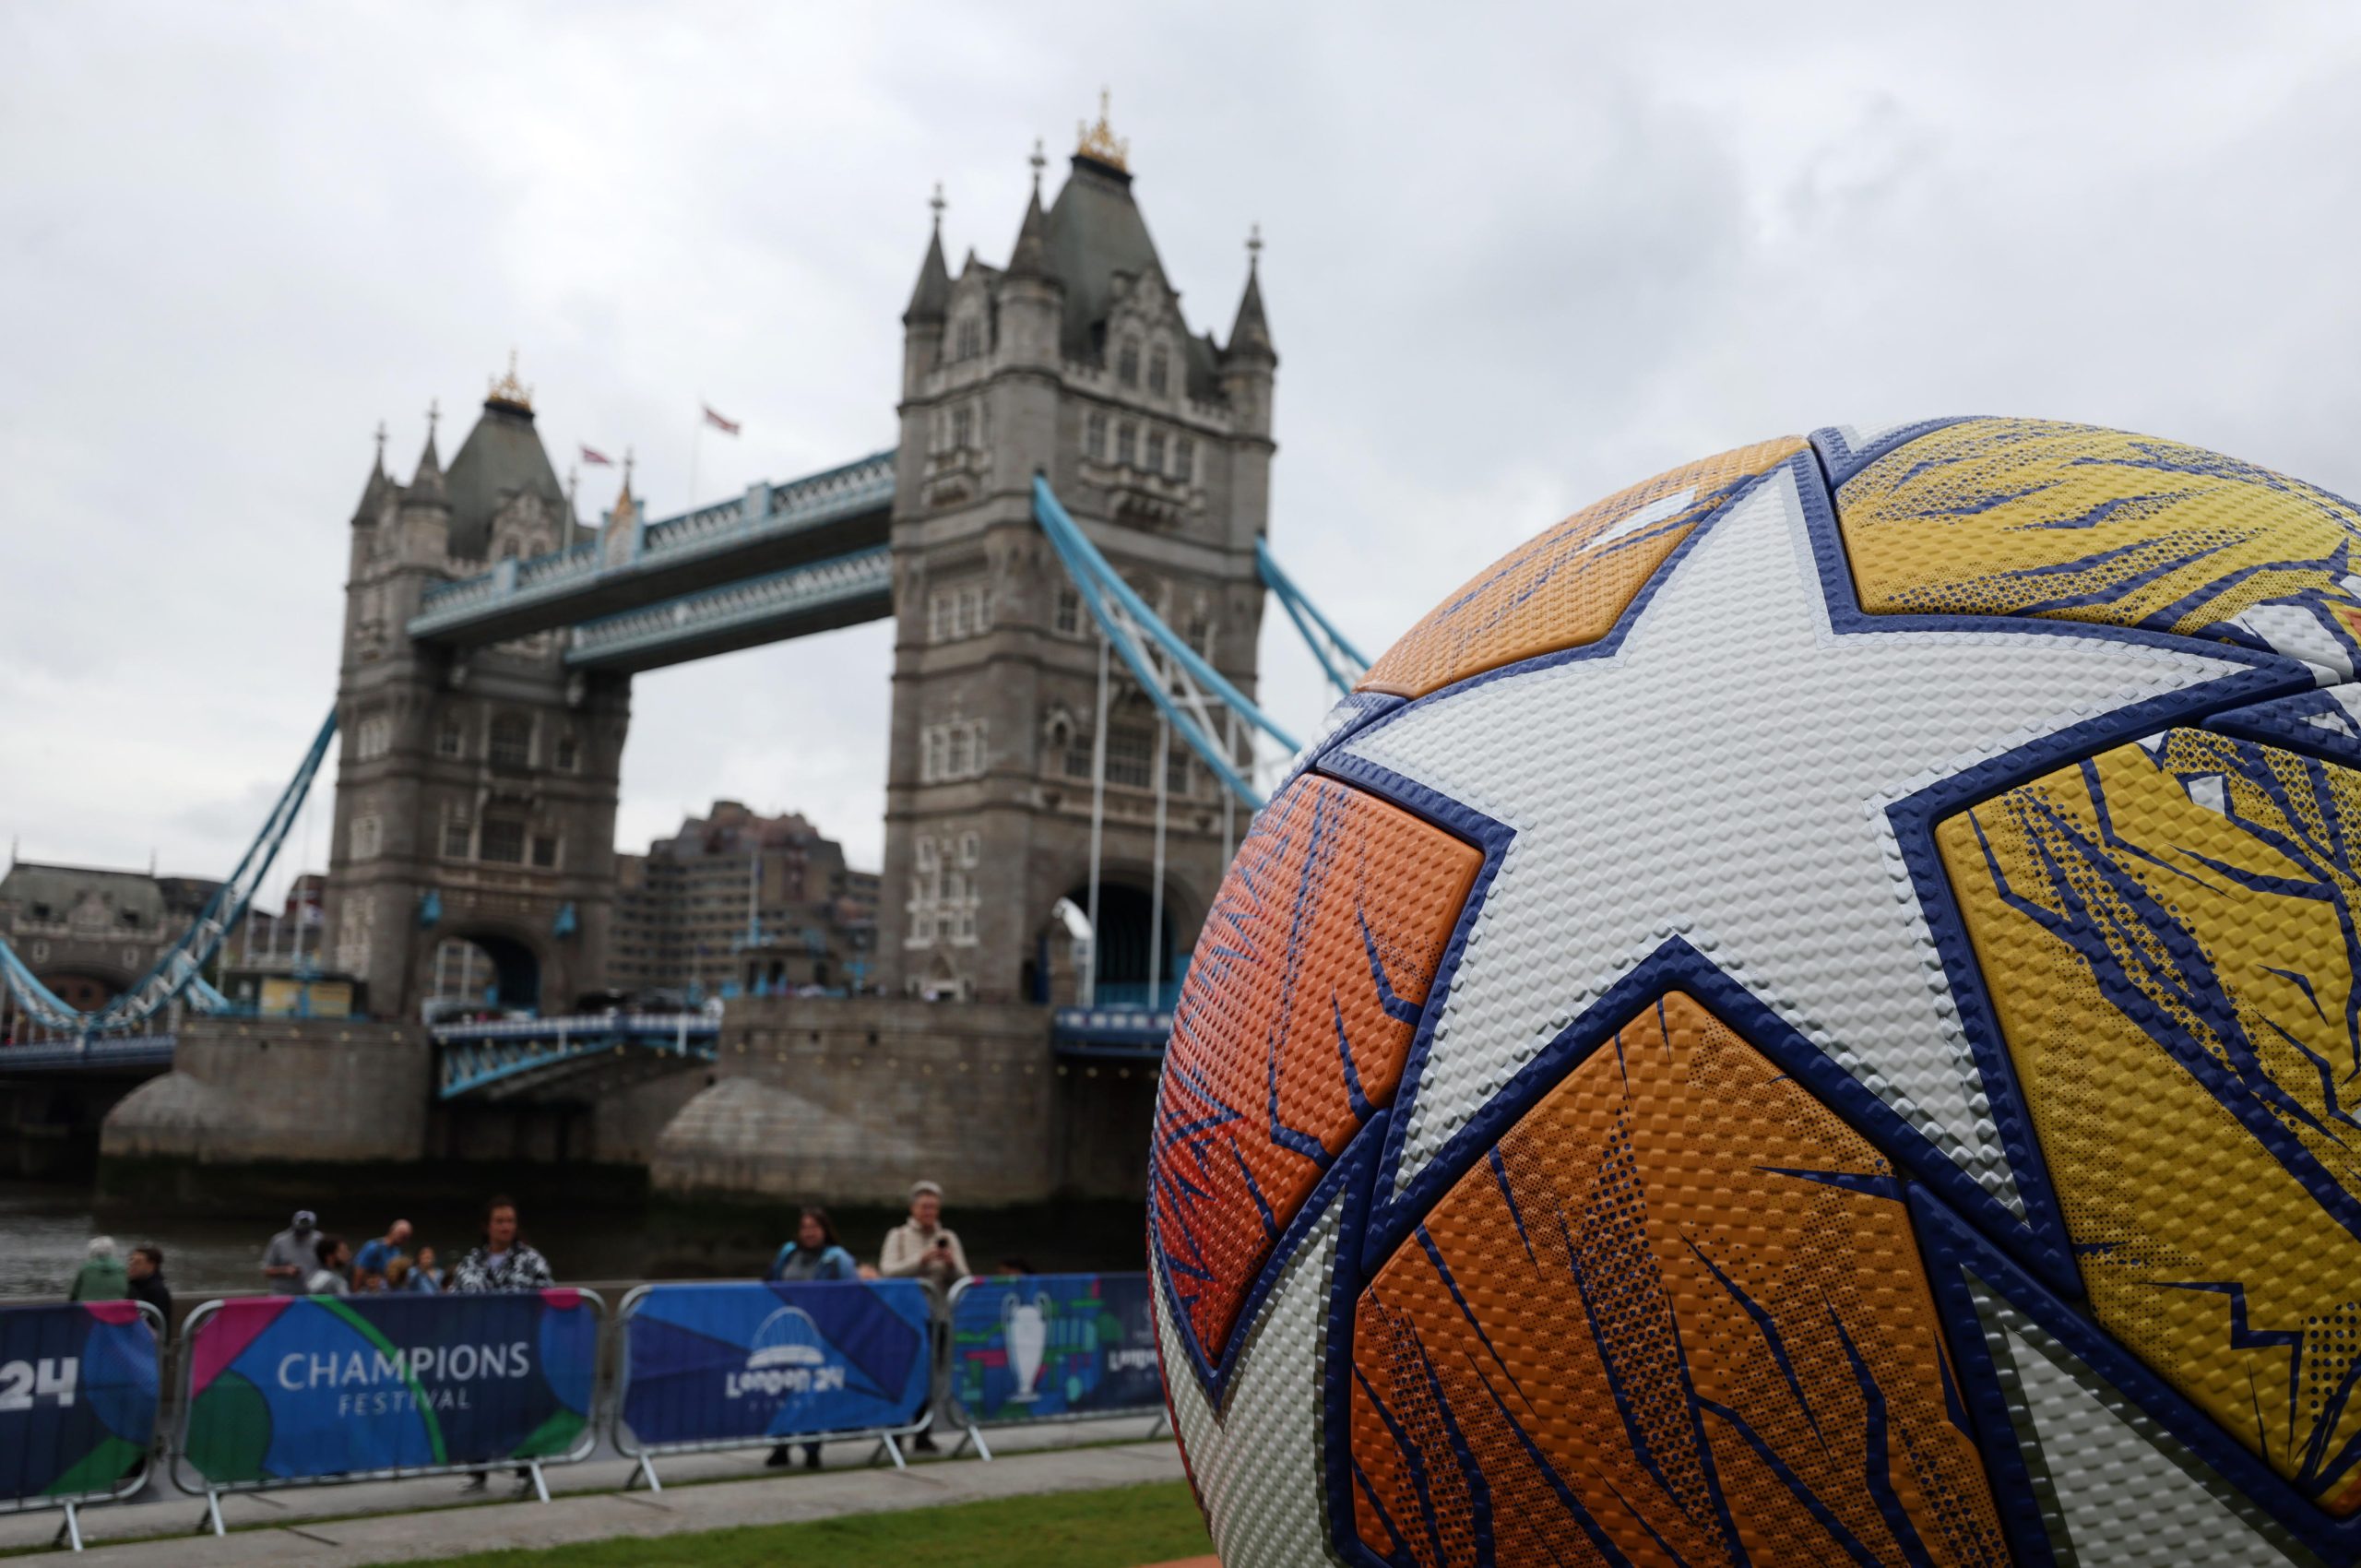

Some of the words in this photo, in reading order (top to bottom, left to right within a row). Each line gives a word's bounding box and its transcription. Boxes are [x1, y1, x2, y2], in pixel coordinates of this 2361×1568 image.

[0, 1356, 78, 1412] 24
[278, 1341, 530, 1391] CHAMPIONS
[338, 1387, 472, 1418] FESTIVAL
